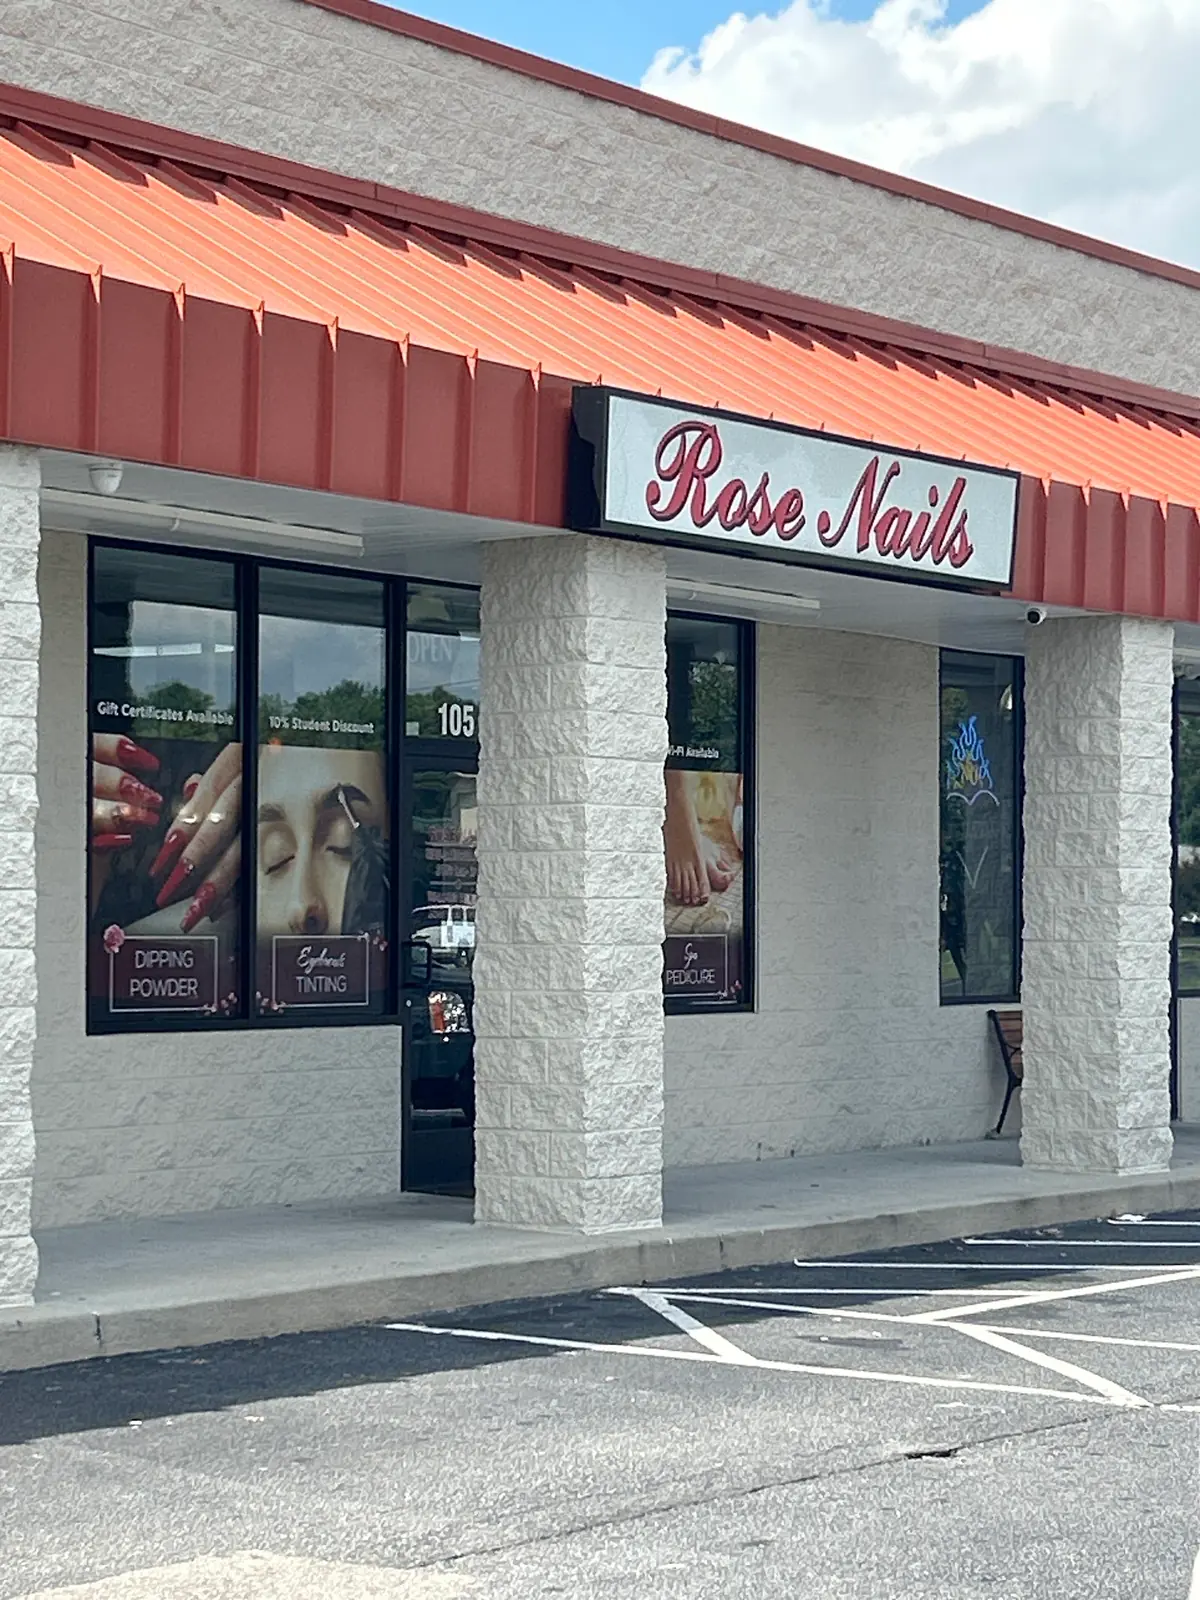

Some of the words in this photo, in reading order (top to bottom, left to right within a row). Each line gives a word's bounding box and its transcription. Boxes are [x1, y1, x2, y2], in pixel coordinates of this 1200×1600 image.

[645, 420, 806, 541] Rose
[817, 455, 974, 569] Nails
[408, 634, 453, 663] OPEN
[97, 701, 119, 716] Gift
[121, 703, 184, 722] Certificates
[185, 709, 234, 726] Available
[438, 702, 475, 738] 105
[269, 716, 290, 729] 10%
[292, 717, 330, 732] Student
[332, 719, 375, 734] Discount
[685, 746, 719, 758] Available
[135, 949, 194, 969] DIPPING
[684, 942, 698, 970] Spa
[295, 975, 347, 993] TINTING
[666, 968, 716, 985] PEDICURE
[129, 977, 198, 998] POWDER
